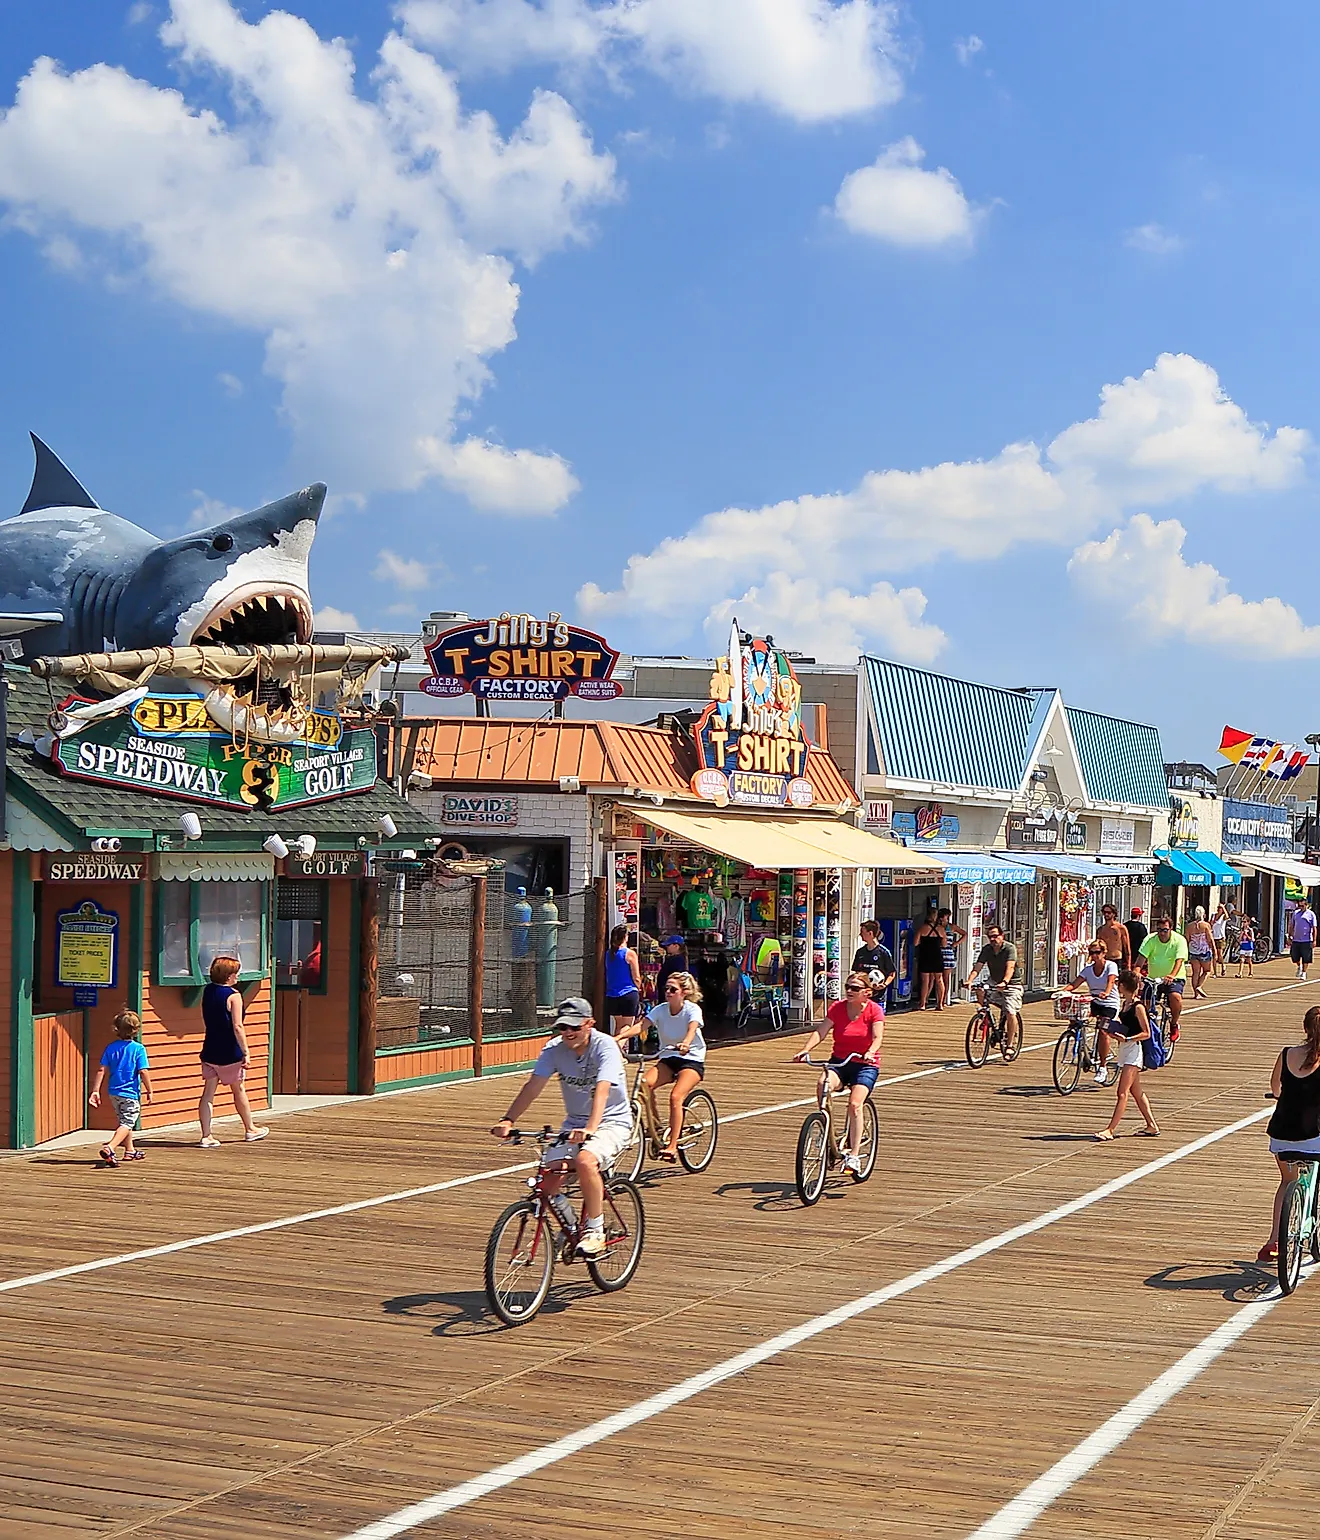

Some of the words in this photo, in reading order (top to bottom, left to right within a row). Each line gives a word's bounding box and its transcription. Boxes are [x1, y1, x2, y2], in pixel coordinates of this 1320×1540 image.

[474, 612, 569, 647] Jilly's
[445, 648, 601, 677] T-SHIRT
[426, 685, 448, 693] OFFICIAL
[449, 686, 463, 694] GEAR
[479, 678, 562, 693] FACTORY
[487, 692, 520, 700] CUSTOM
[523, 692, 554, 700] DECALS
[127, 736, 185, 761] SEASIDE
[709, 731, 805, 775] T-SHIRT
[77, 741, 228, 795] SPEEDWAY
[294, 754, 330, 773] SEAPORT
[331, 748, 364, 767] VILLAGE
[305, 763, 354, 796] GOLF
[734, 774, 784, 795] FACTORY
[447, 797, 513, 812] DAVID'S
[867, 803, 887, 817] ATM
[447, 812, 475, 822] DIVE
[479, 813, 511, 823] SHOP
[1227, 818, 1248, 835] OCEAN
[1248, 819, 1260, 836] CITY
[1264, 821, 1284, 838] COFFEE
[77, 854, 116, 864] SEASIDE
[328, 852, 359, 862] VILLAGE
[51, 863, 142, 880] SPEEDWAY
[302, 860, 350, 875] GOLF
